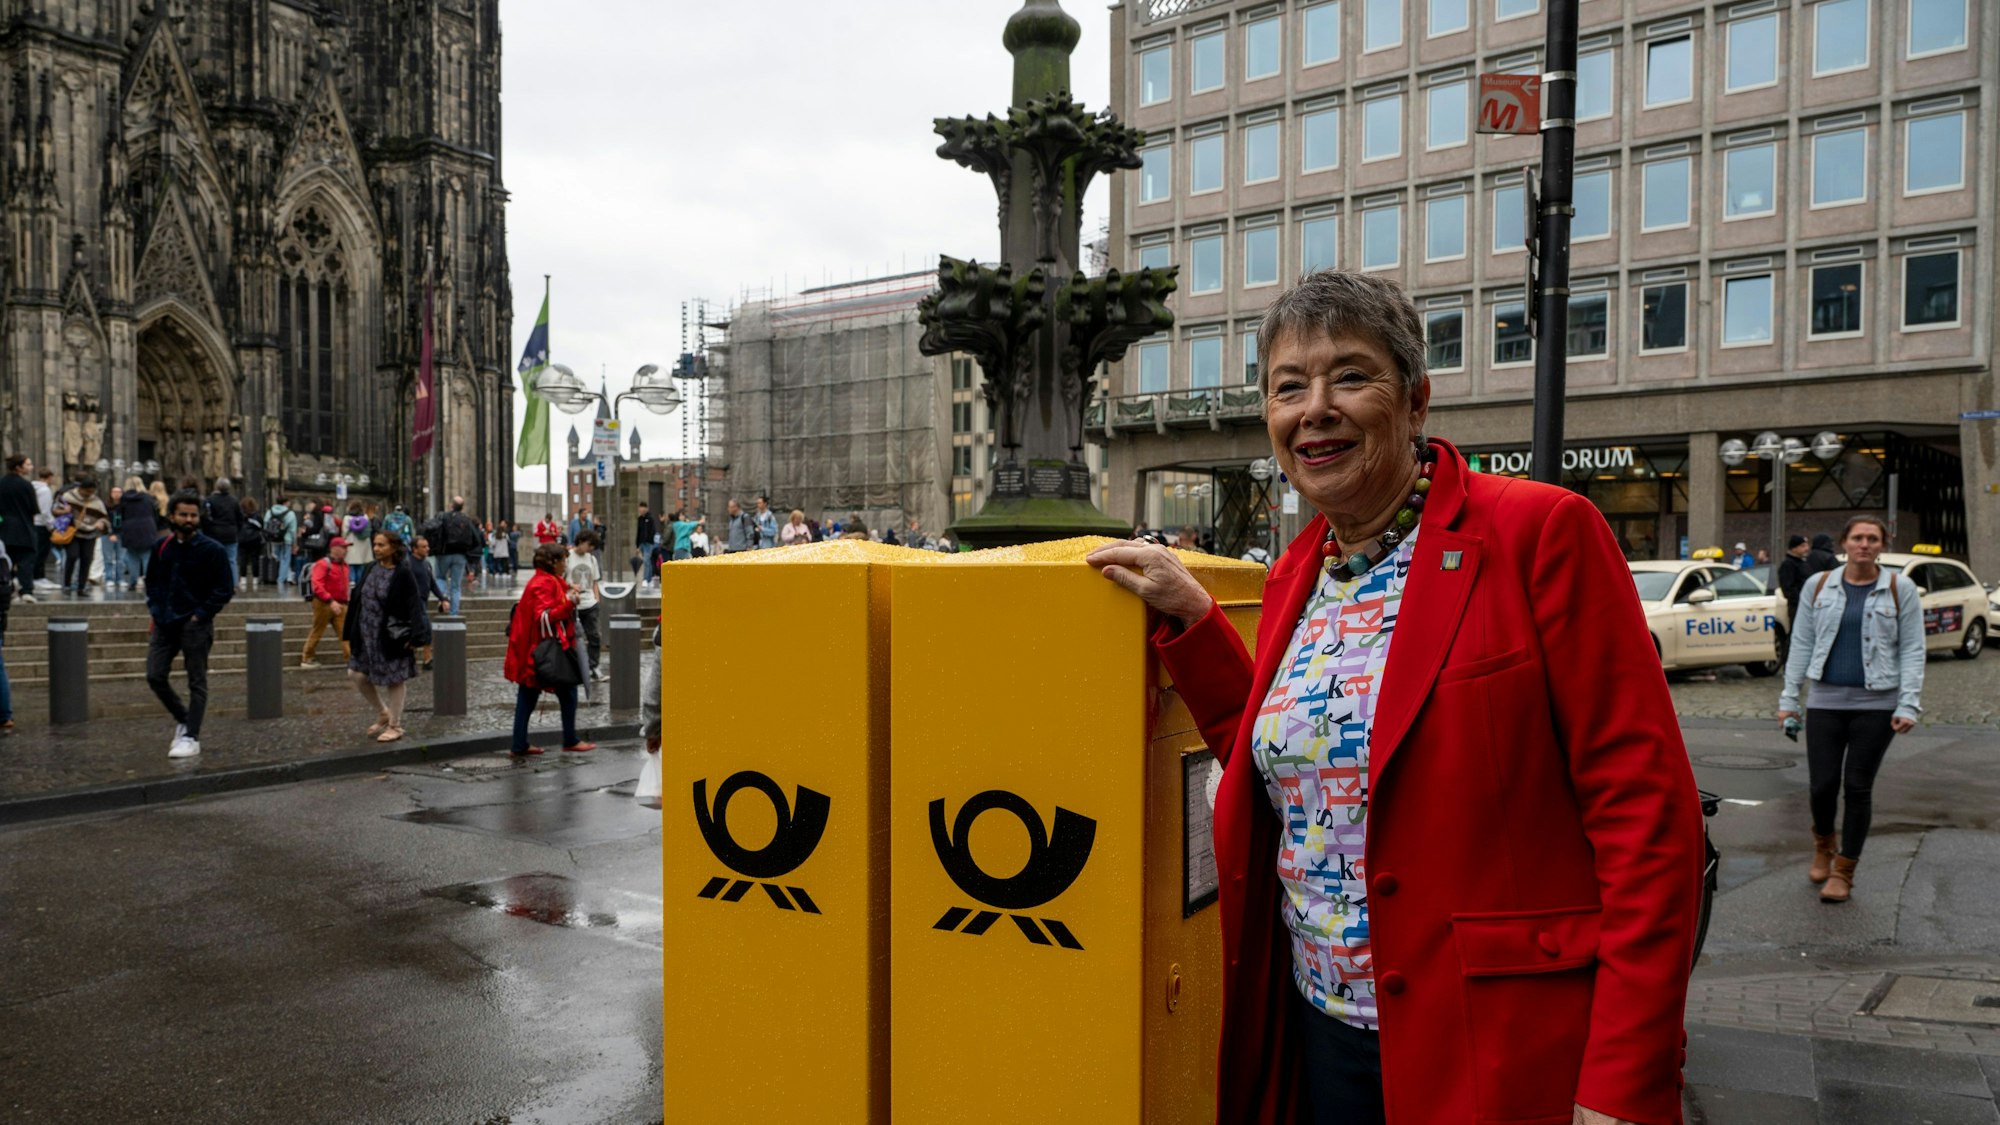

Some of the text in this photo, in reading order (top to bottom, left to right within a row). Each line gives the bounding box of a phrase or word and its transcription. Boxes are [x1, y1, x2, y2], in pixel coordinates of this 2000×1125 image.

[1484, 77, 1521, 87] Museum
[1482, 98, 1519, 130] M
[1491, 447, 1634, 473] DOORUM
[1685, 617, 1735, 636] Felix
